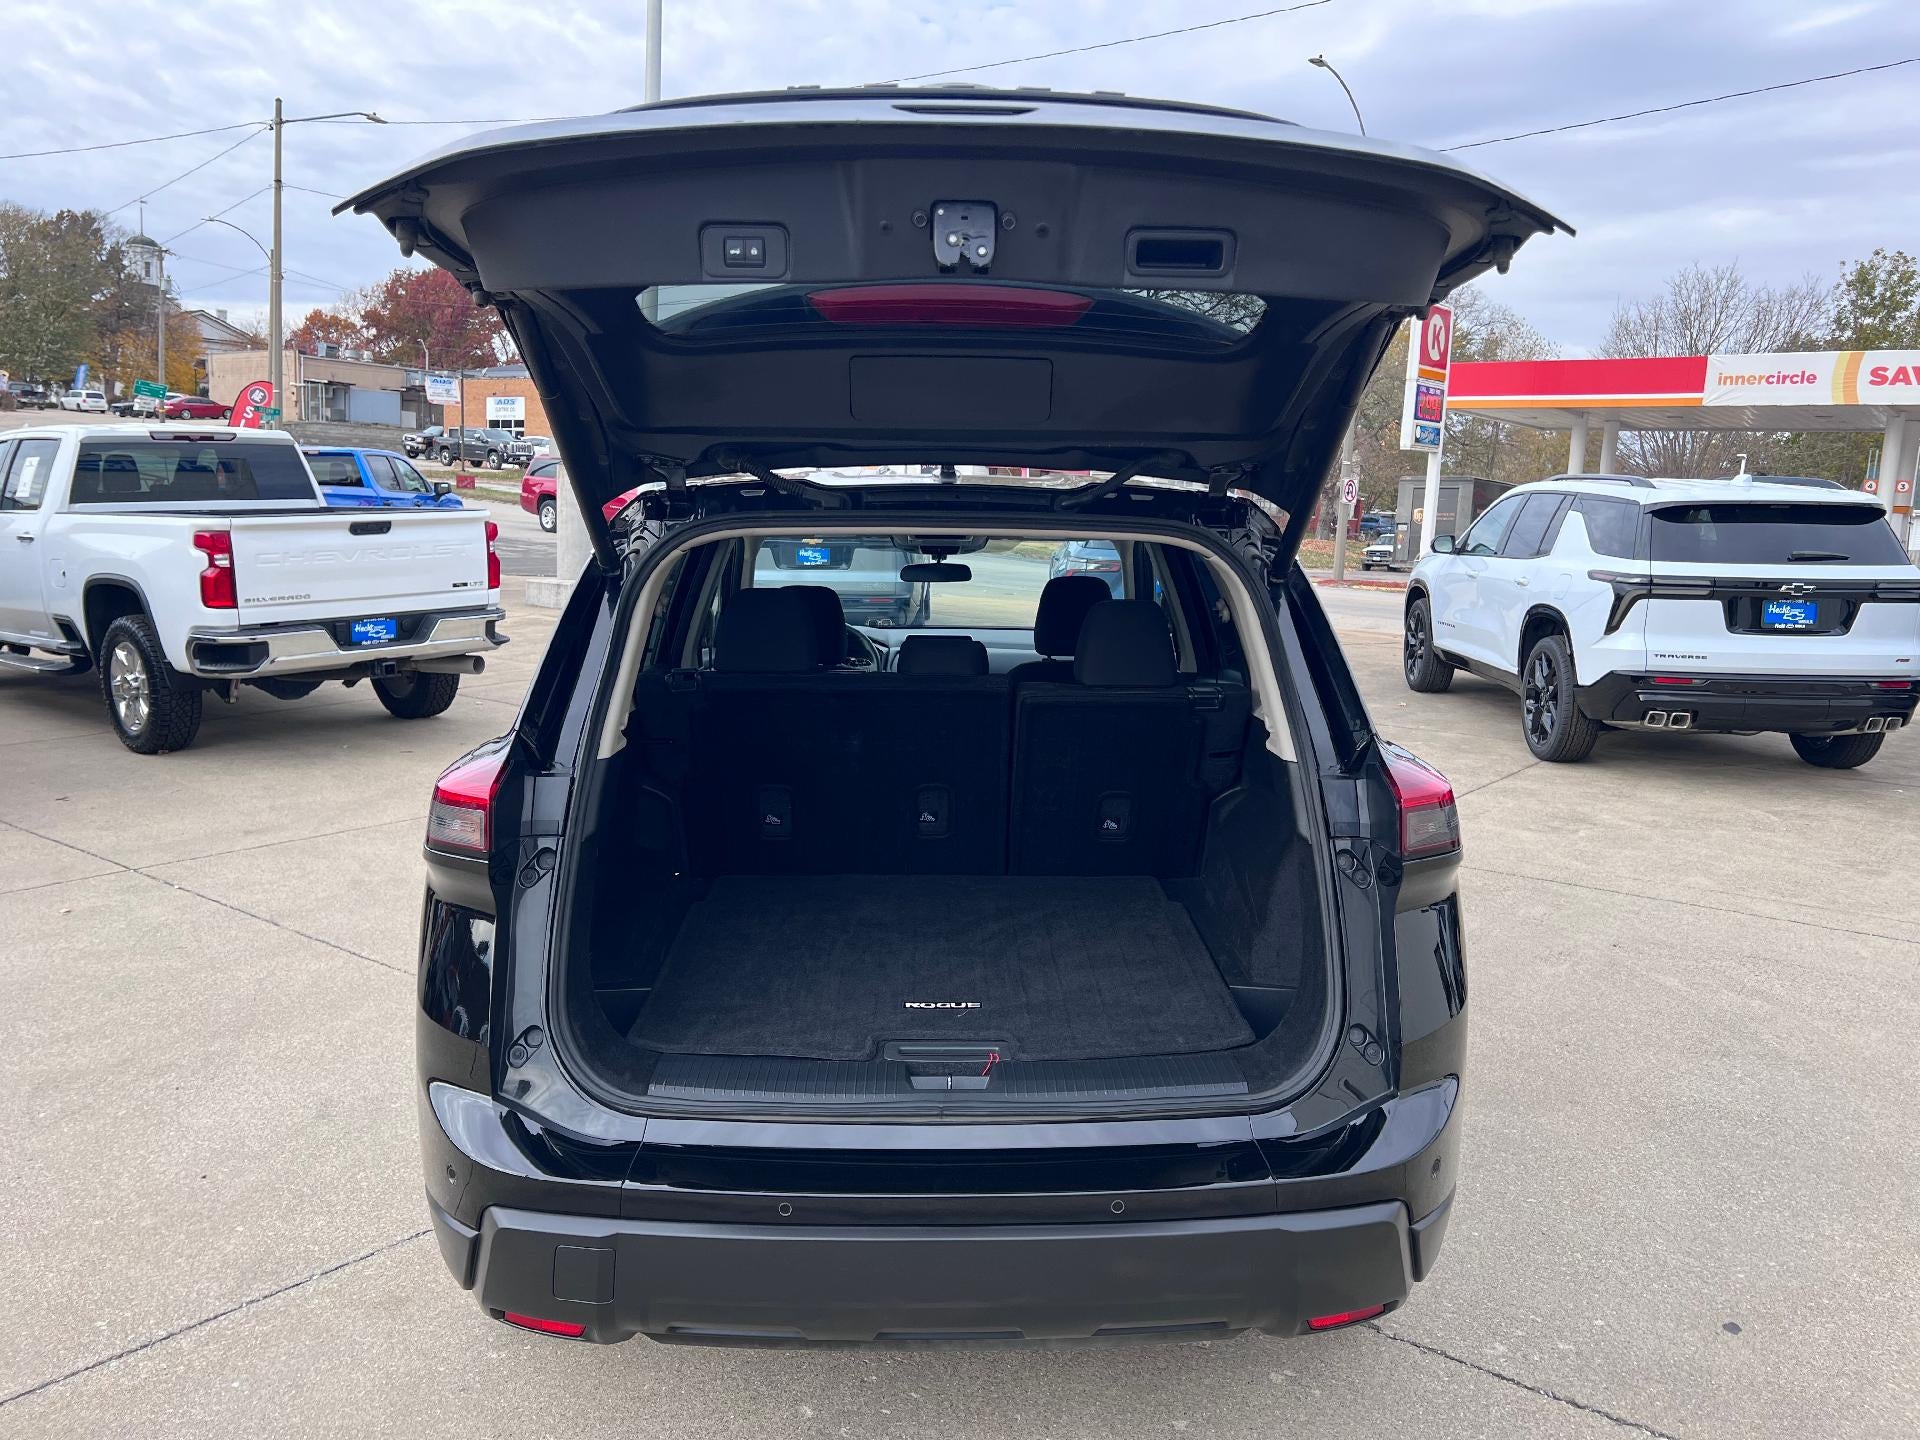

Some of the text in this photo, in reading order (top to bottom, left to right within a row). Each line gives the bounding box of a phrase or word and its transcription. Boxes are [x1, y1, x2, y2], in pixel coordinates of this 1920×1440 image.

[1717, 370, 1818, 386] innercircle
[256, 543, 473, 567] CHEVROLET
[244, 594, 311, 603] SILVERADO
[1768, 604, 1790, 614] Hecht
